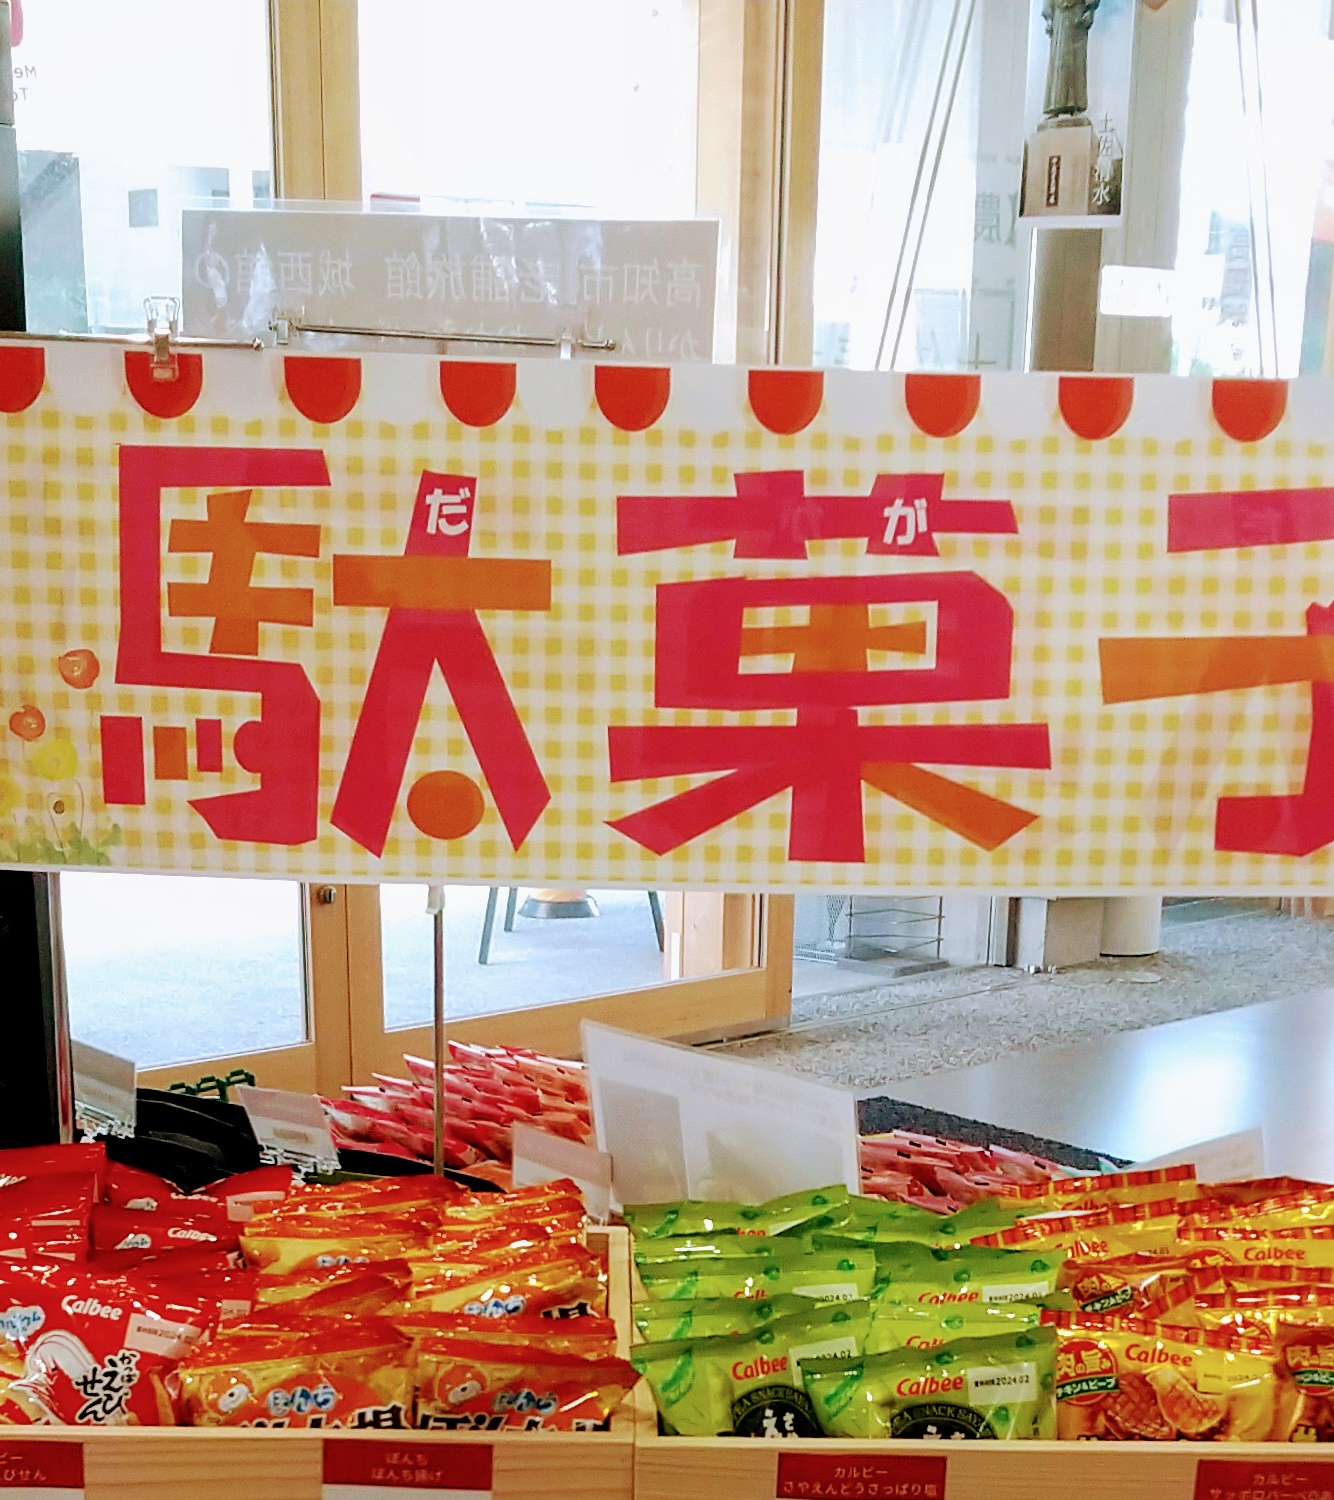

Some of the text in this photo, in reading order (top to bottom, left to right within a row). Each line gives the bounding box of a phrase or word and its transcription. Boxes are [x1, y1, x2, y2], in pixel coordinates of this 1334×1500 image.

[425, 487, 470, 536] だ
[881, 496, 930, 546] が
[1243, 1246, 1305, 1262] Calbee
[61, 1294, 123, 1321] Calbee
[1124, 1343, 1194, 1367] Calbee
[732, 1355, 789, 1381] Calbee
[896, 1373, 965, 1397] Calbee
[834, 1466, 889, 1480] カルビー
[782, 1482, 938, 1497] さやえんどうさっぱり塩
